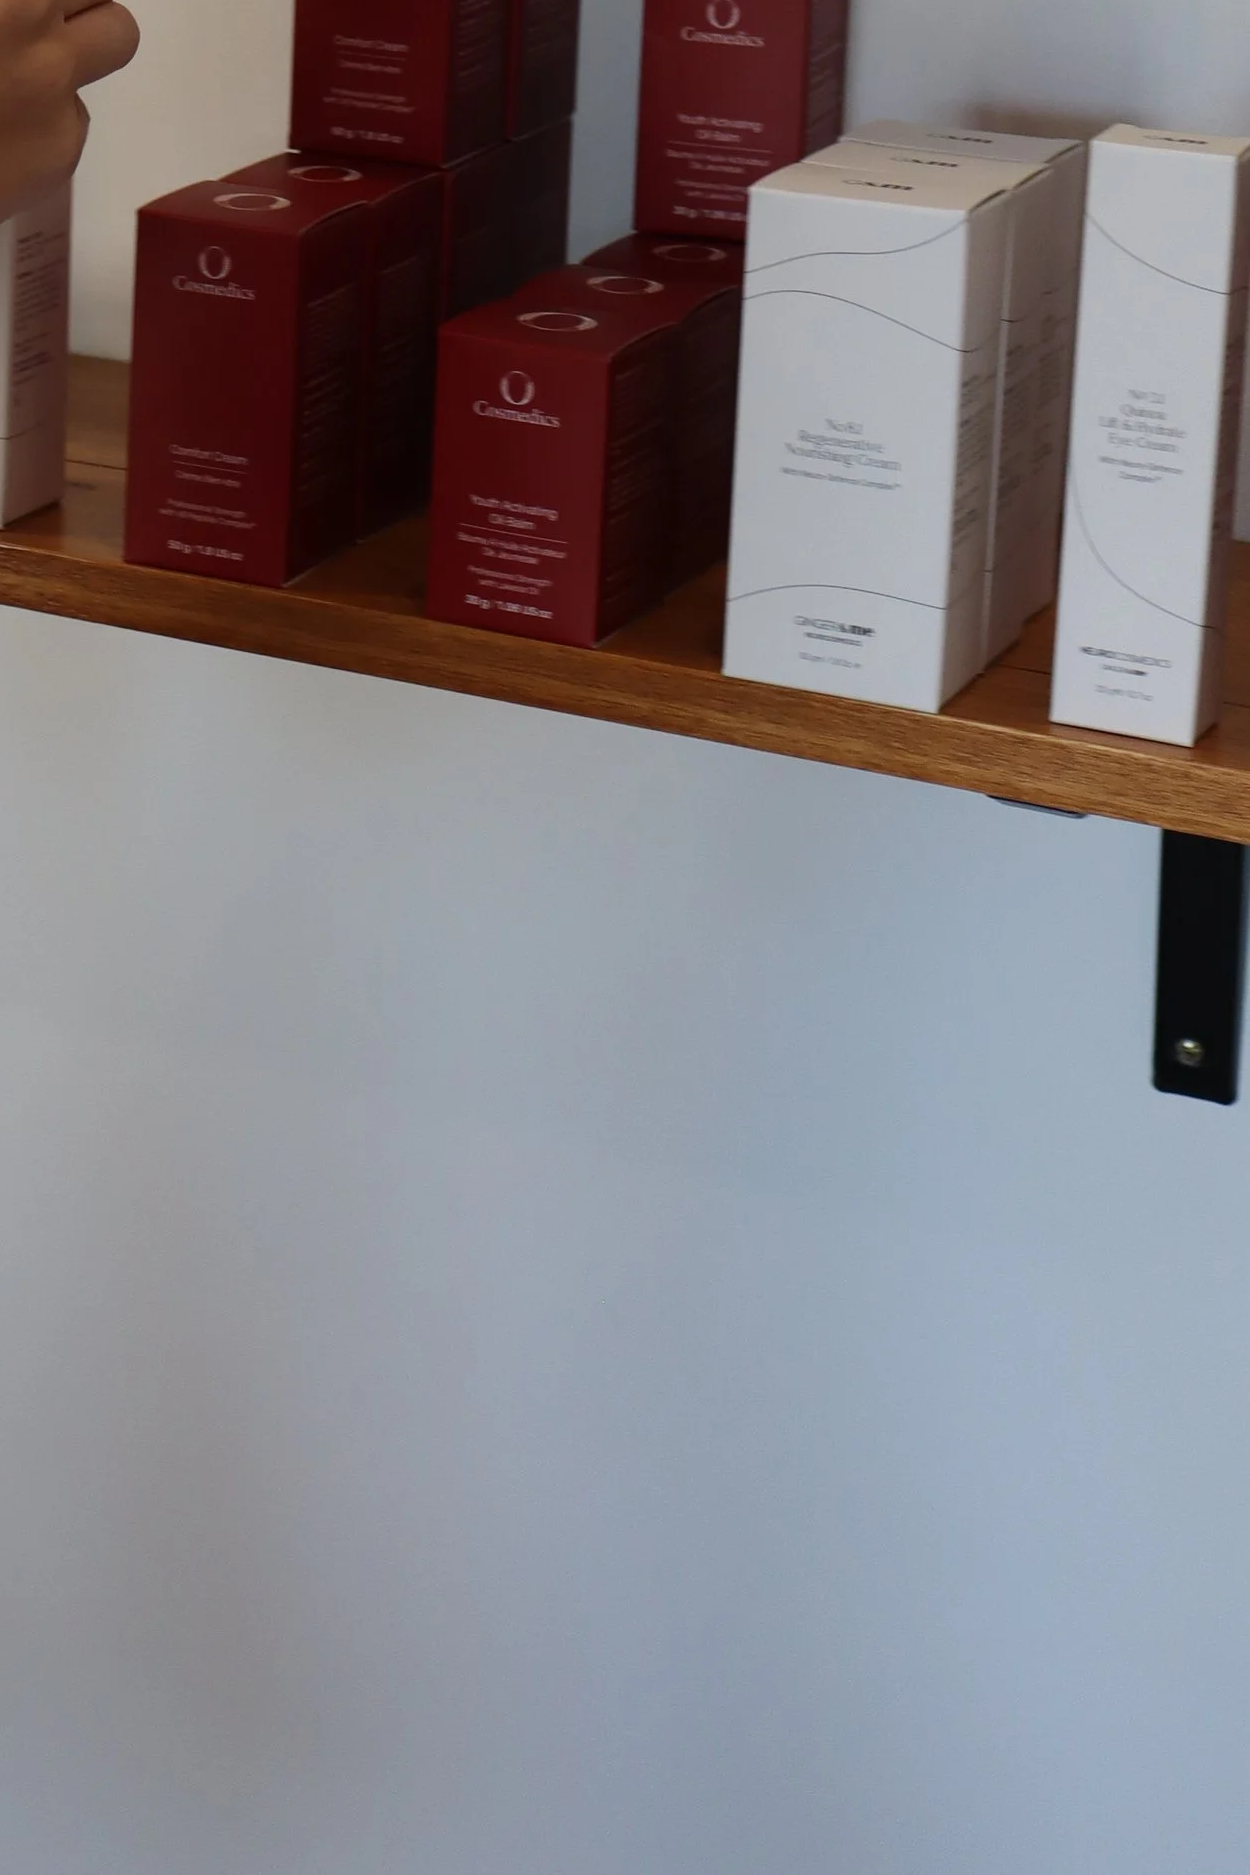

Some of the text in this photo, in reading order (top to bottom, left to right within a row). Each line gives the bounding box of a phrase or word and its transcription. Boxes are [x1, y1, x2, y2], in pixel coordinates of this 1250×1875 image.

[680, 26, 765, 48] Cosmedics
[172, 274, 256, 301] Cosmedics
[472, 400, 561, 428] Cosmedics
